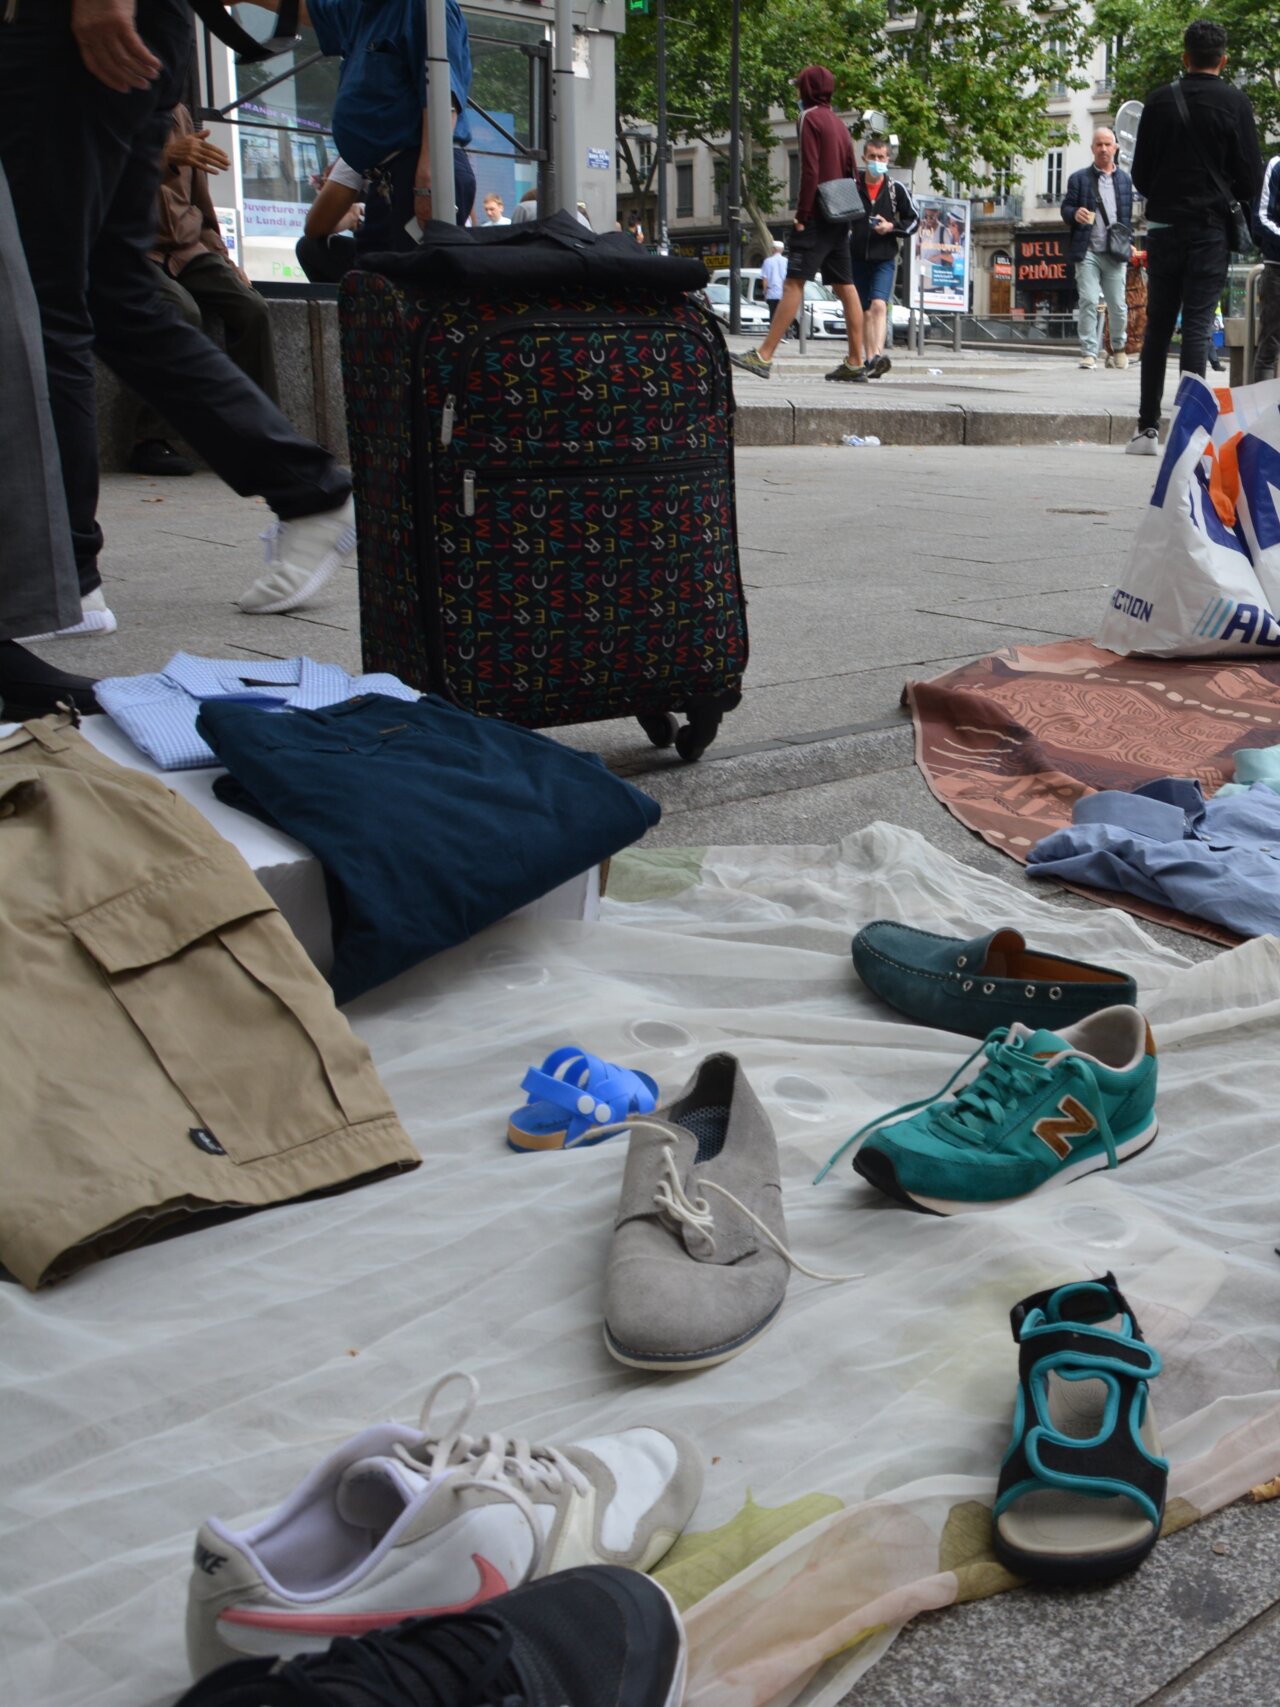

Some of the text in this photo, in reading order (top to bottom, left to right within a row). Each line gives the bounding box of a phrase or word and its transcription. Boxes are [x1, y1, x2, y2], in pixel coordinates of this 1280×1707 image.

[256, 215, 287, 227] Lundi
[1021, 241, 1064, 258] WELL
[1018, 260, 1068, 280] PHONE
[1110, 588, 1154, 624] CTION
